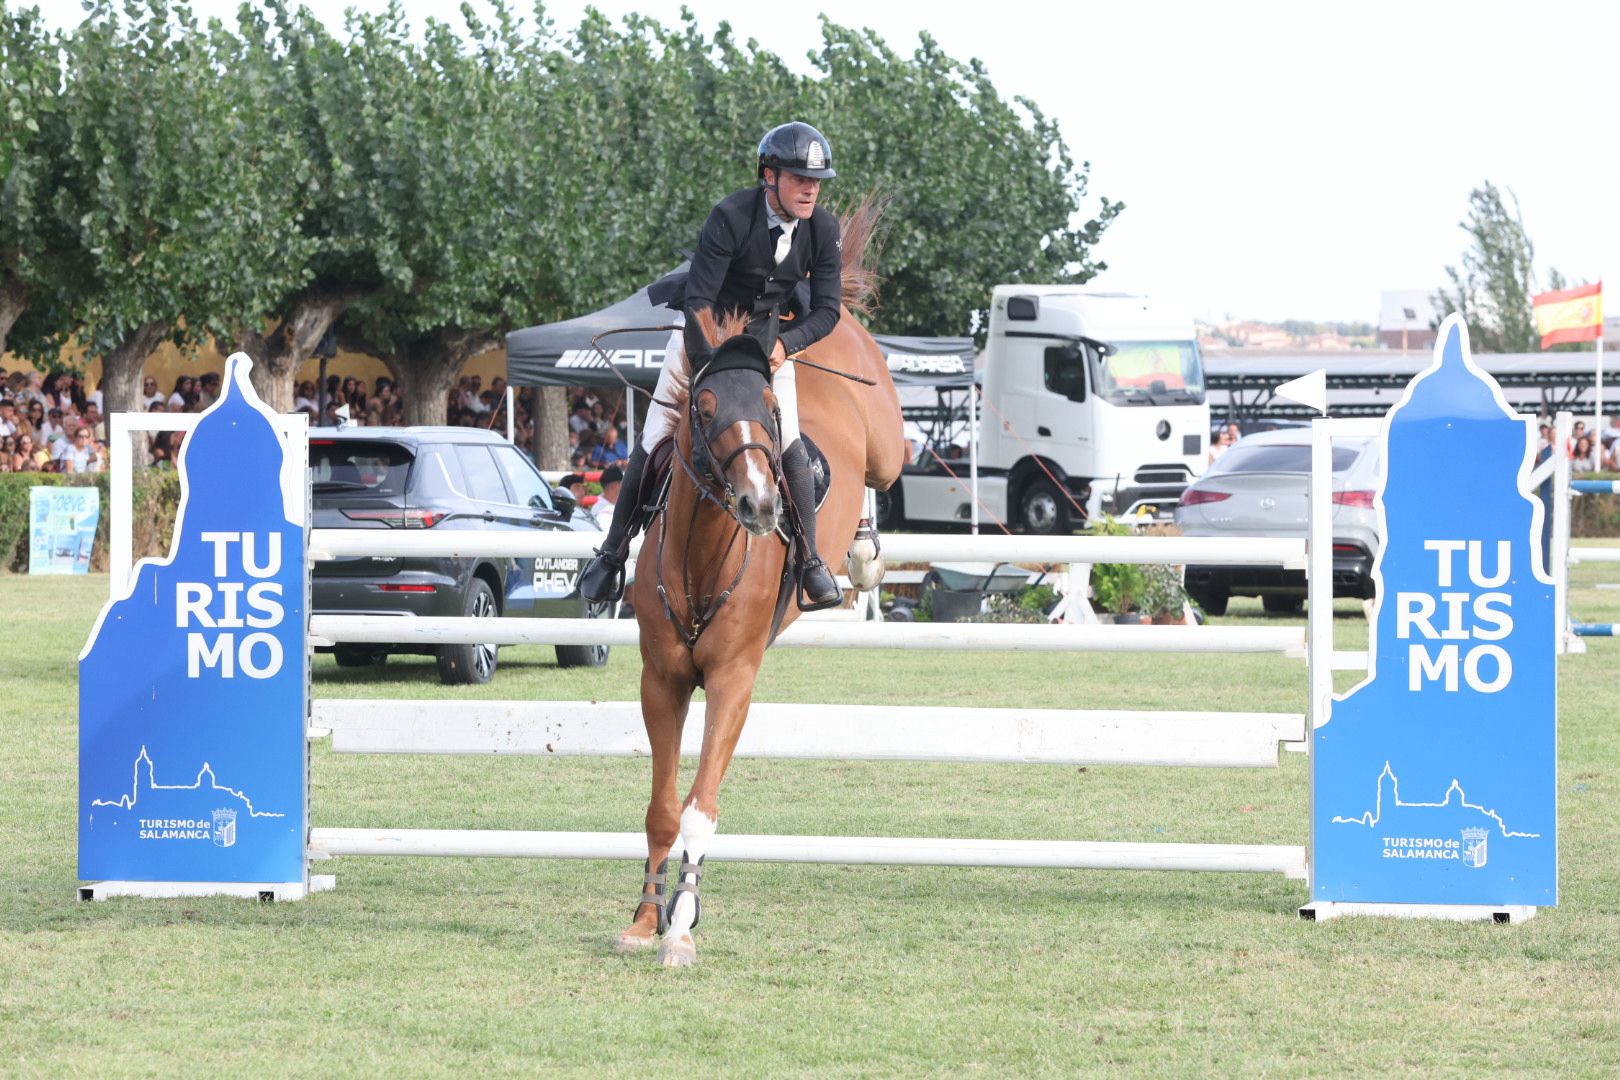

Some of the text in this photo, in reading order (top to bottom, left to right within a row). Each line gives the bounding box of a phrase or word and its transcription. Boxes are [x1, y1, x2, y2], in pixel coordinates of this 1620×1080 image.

[200, 532, 282, 579] TU
[534, 558, 578, 571] OUTLANDER
[1423, 540, 1511, 589] TU
[533, 572, 578, 593] PHEV
[176, 582, 285, 629] RIS
[1396, 592, 1514, 641] RIS
[187, 632, 284, 679] MO
[1408, 644, 1513, 693] MO
[139, 819, 211, 829] TURISMO de
[139, 830, 211, 839] SALAMANCA
[1383, 837, 1460, 849] TURISMO de
[1383, 848, 1460, 860] SALAMANCA
